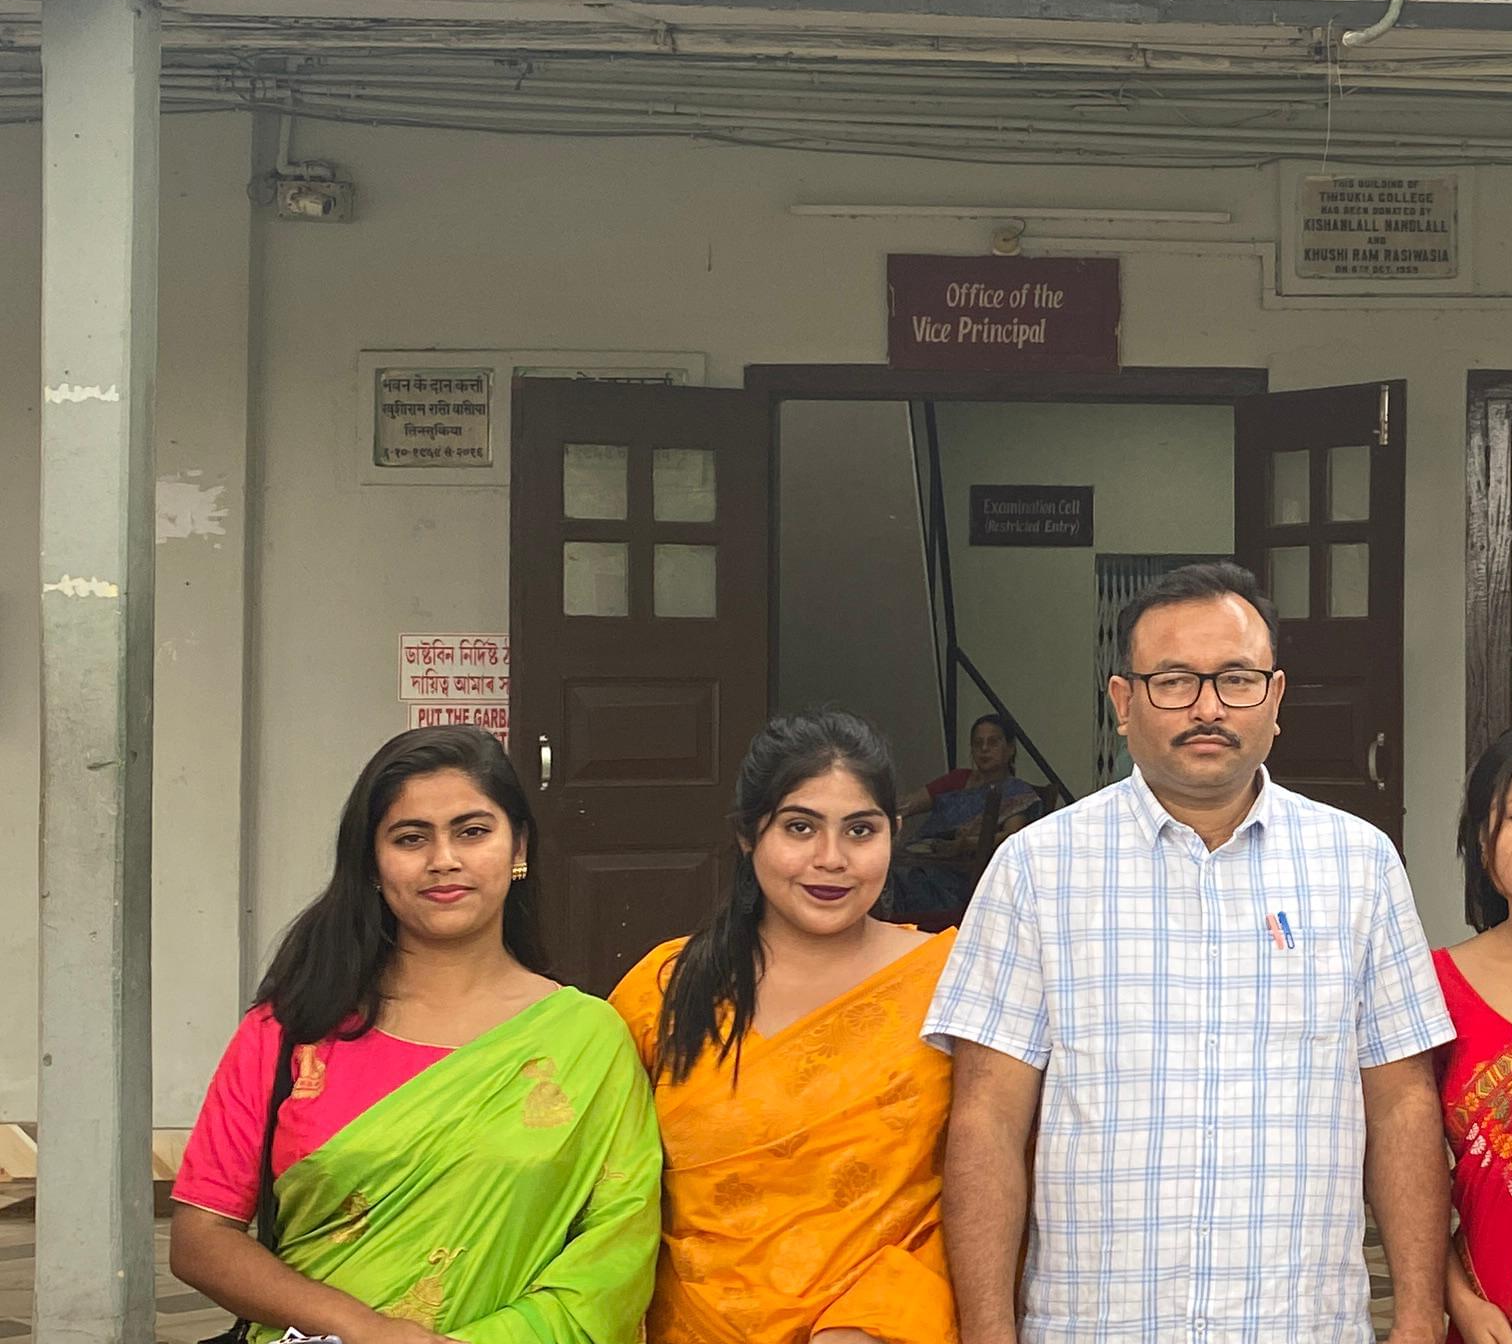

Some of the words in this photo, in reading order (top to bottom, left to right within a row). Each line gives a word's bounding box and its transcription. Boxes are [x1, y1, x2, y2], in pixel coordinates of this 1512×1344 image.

[1319, 192, 1374, 203] TINSUKIA
[1378, 193, 1433, 204] COLLEGE
[1372, 207, 1416, 216] DONATED
[1420, 207, 1432, 216] BY
[1303, 219, 1379, 232] KISHANLALL
[1384, 220, 1448, 233] NANDLALL
[1304, 248, 1348, 262] KHUSHI
[1352, 248, 1379, 262] RAM
[1383, 248, 1449, 262] RASIWASIA
[946, 282, 1004, 308] Office
[1009, 283, 1031, 308] of
[1034, 284, 1064, 308] the
[912, 316, 951, 343] Vice
[958, 316, 1047, 349] Principal
[413, 374, 427, 393] के
[983, 498, 1056, 514] Examination
[1059, 499, 1080, 515] Cell
[418, 708, 442, 727] PUT
[446, 708, 469, 725] THE
[474, 708, 510, 728] GARB
